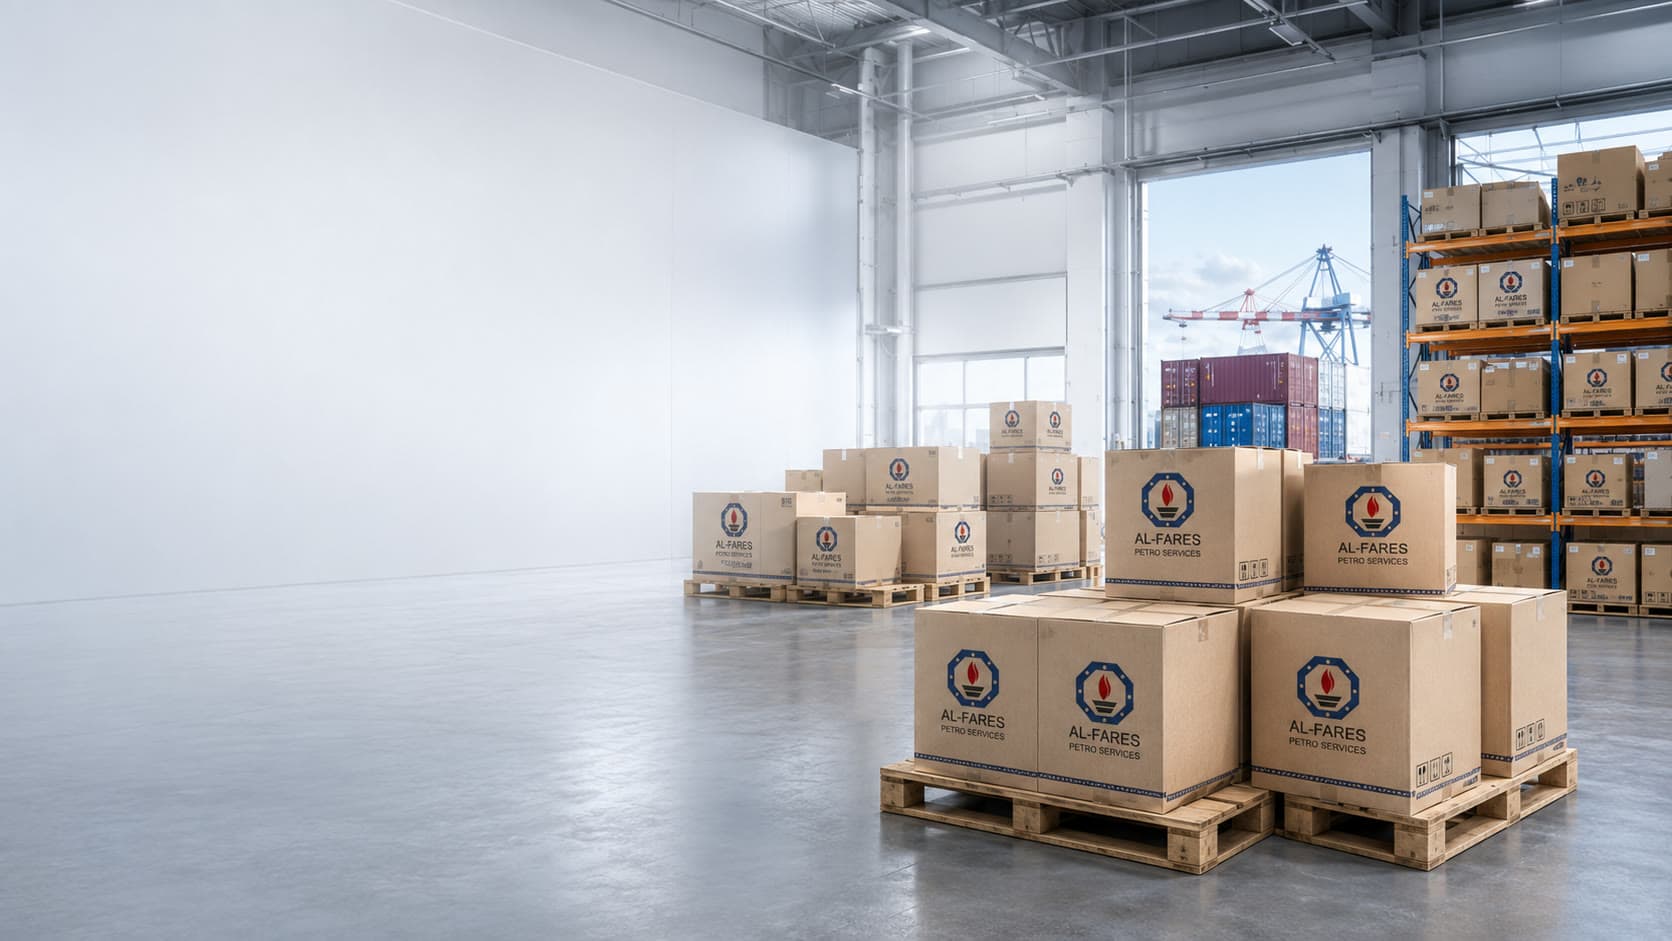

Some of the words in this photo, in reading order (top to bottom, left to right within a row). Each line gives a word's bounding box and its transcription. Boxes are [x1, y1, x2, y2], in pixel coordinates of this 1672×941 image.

[715, 540, 753, 550] AL-FARES
[1134, 533, 1201, 546] AL-FARES
[1134, 548, 1160, 557] PETRO
[1162, 549, 1200, 558] SERVICES
[1338, 542, 1408, 554] AL-FARES
[1337, 557, 1365, 565] PETRO
[1367, 557, 1408, 566] SERVICES
[941, 709, 1005, 729] AL-FARES
[941, 725, 966, 736] PETRO
[967, 726, 1005, 741] SERVICES
[1069, 725, 1141, 747] AL-FARES
[1289, 719, 1366, 742] AL-FARES
[1069, 742, 1097, 754] PETRO
[1098, 746, 1141, 760] SERVICES
[1289, 737, 1319, 749] PETRO
[1321, 741, 1366, 755] SERVICES
